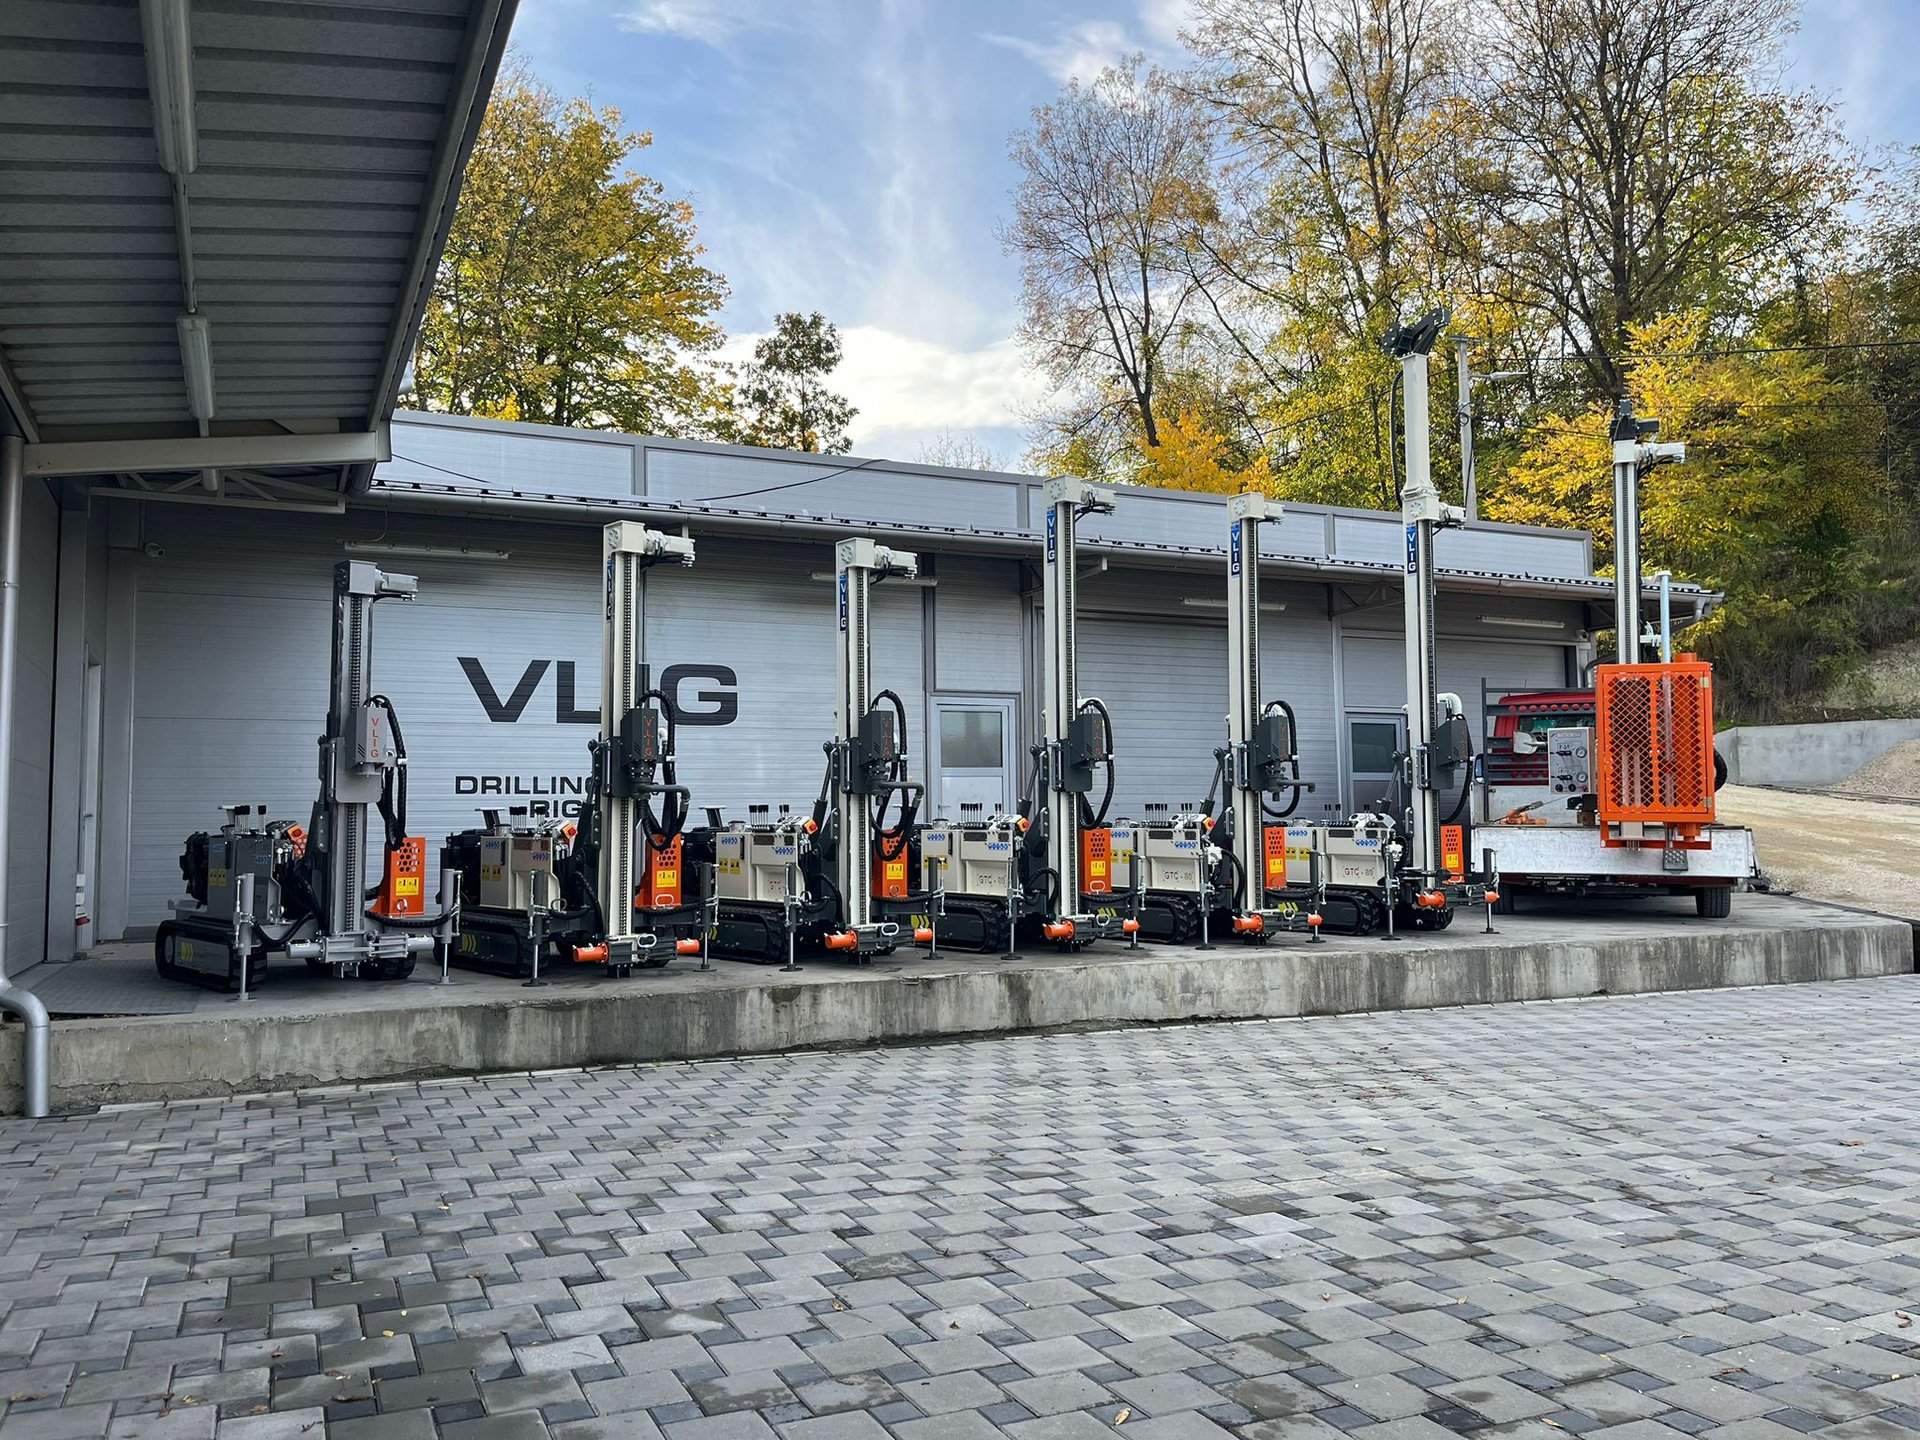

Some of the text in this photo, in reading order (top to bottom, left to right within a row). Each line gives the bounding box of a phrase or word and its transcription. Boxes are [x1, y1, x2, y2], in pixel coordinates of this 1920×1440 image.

[1047, 517, 1055, 560] VLIG
[1231, 532, 1240, 573] VLIG
[1407, 533, 1417, 571] VLIG
[370, 717, 380, 759] VLIG
[645, 718, 653, 757] VLIG
